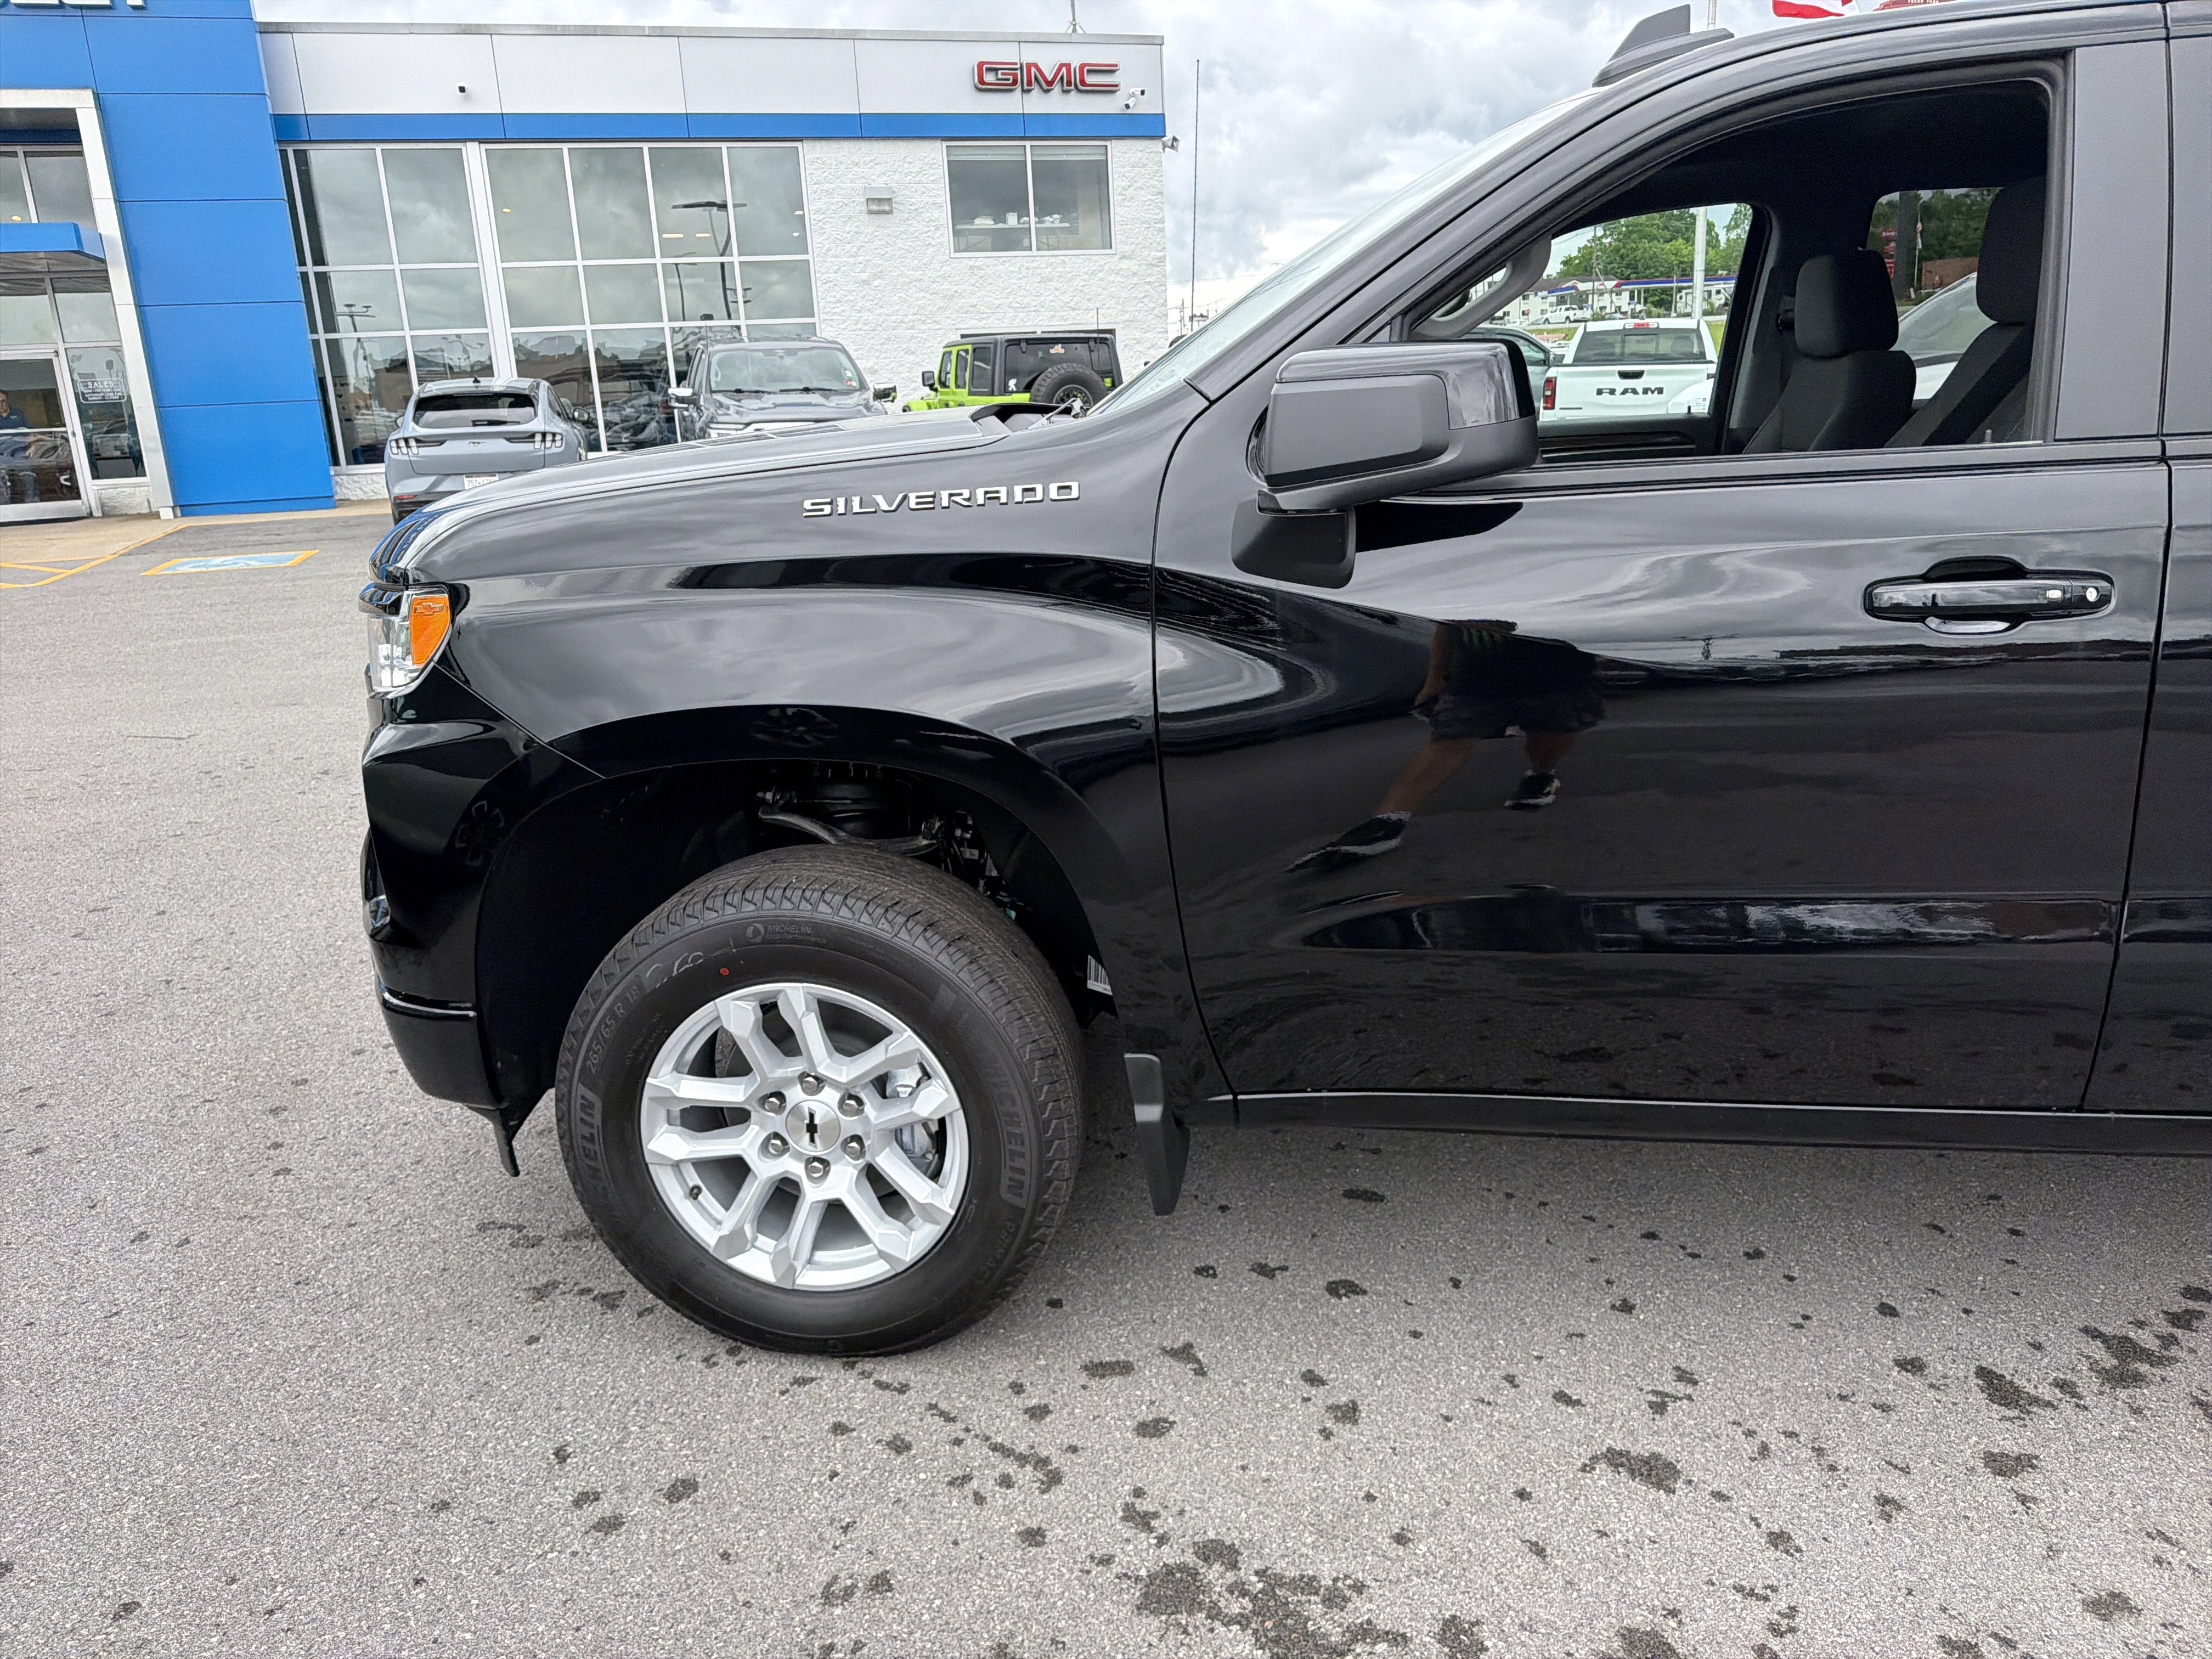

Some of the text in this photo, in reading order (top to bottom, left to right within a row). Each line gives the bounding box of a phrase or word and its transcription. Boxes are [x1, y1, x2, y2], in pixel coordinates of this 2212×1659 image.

[973, 59, 1120, 91] GMC
[1596, 387, 1664, 396] RAM
[802, 481, 1080, 517] SILVERADO
[768, 923, 812, 933] MICHELIN
[782, 933, 827, 944] Performance
[586, 1015, 616, 1074] 265/65
[614, 1003, 625, 1017] R
